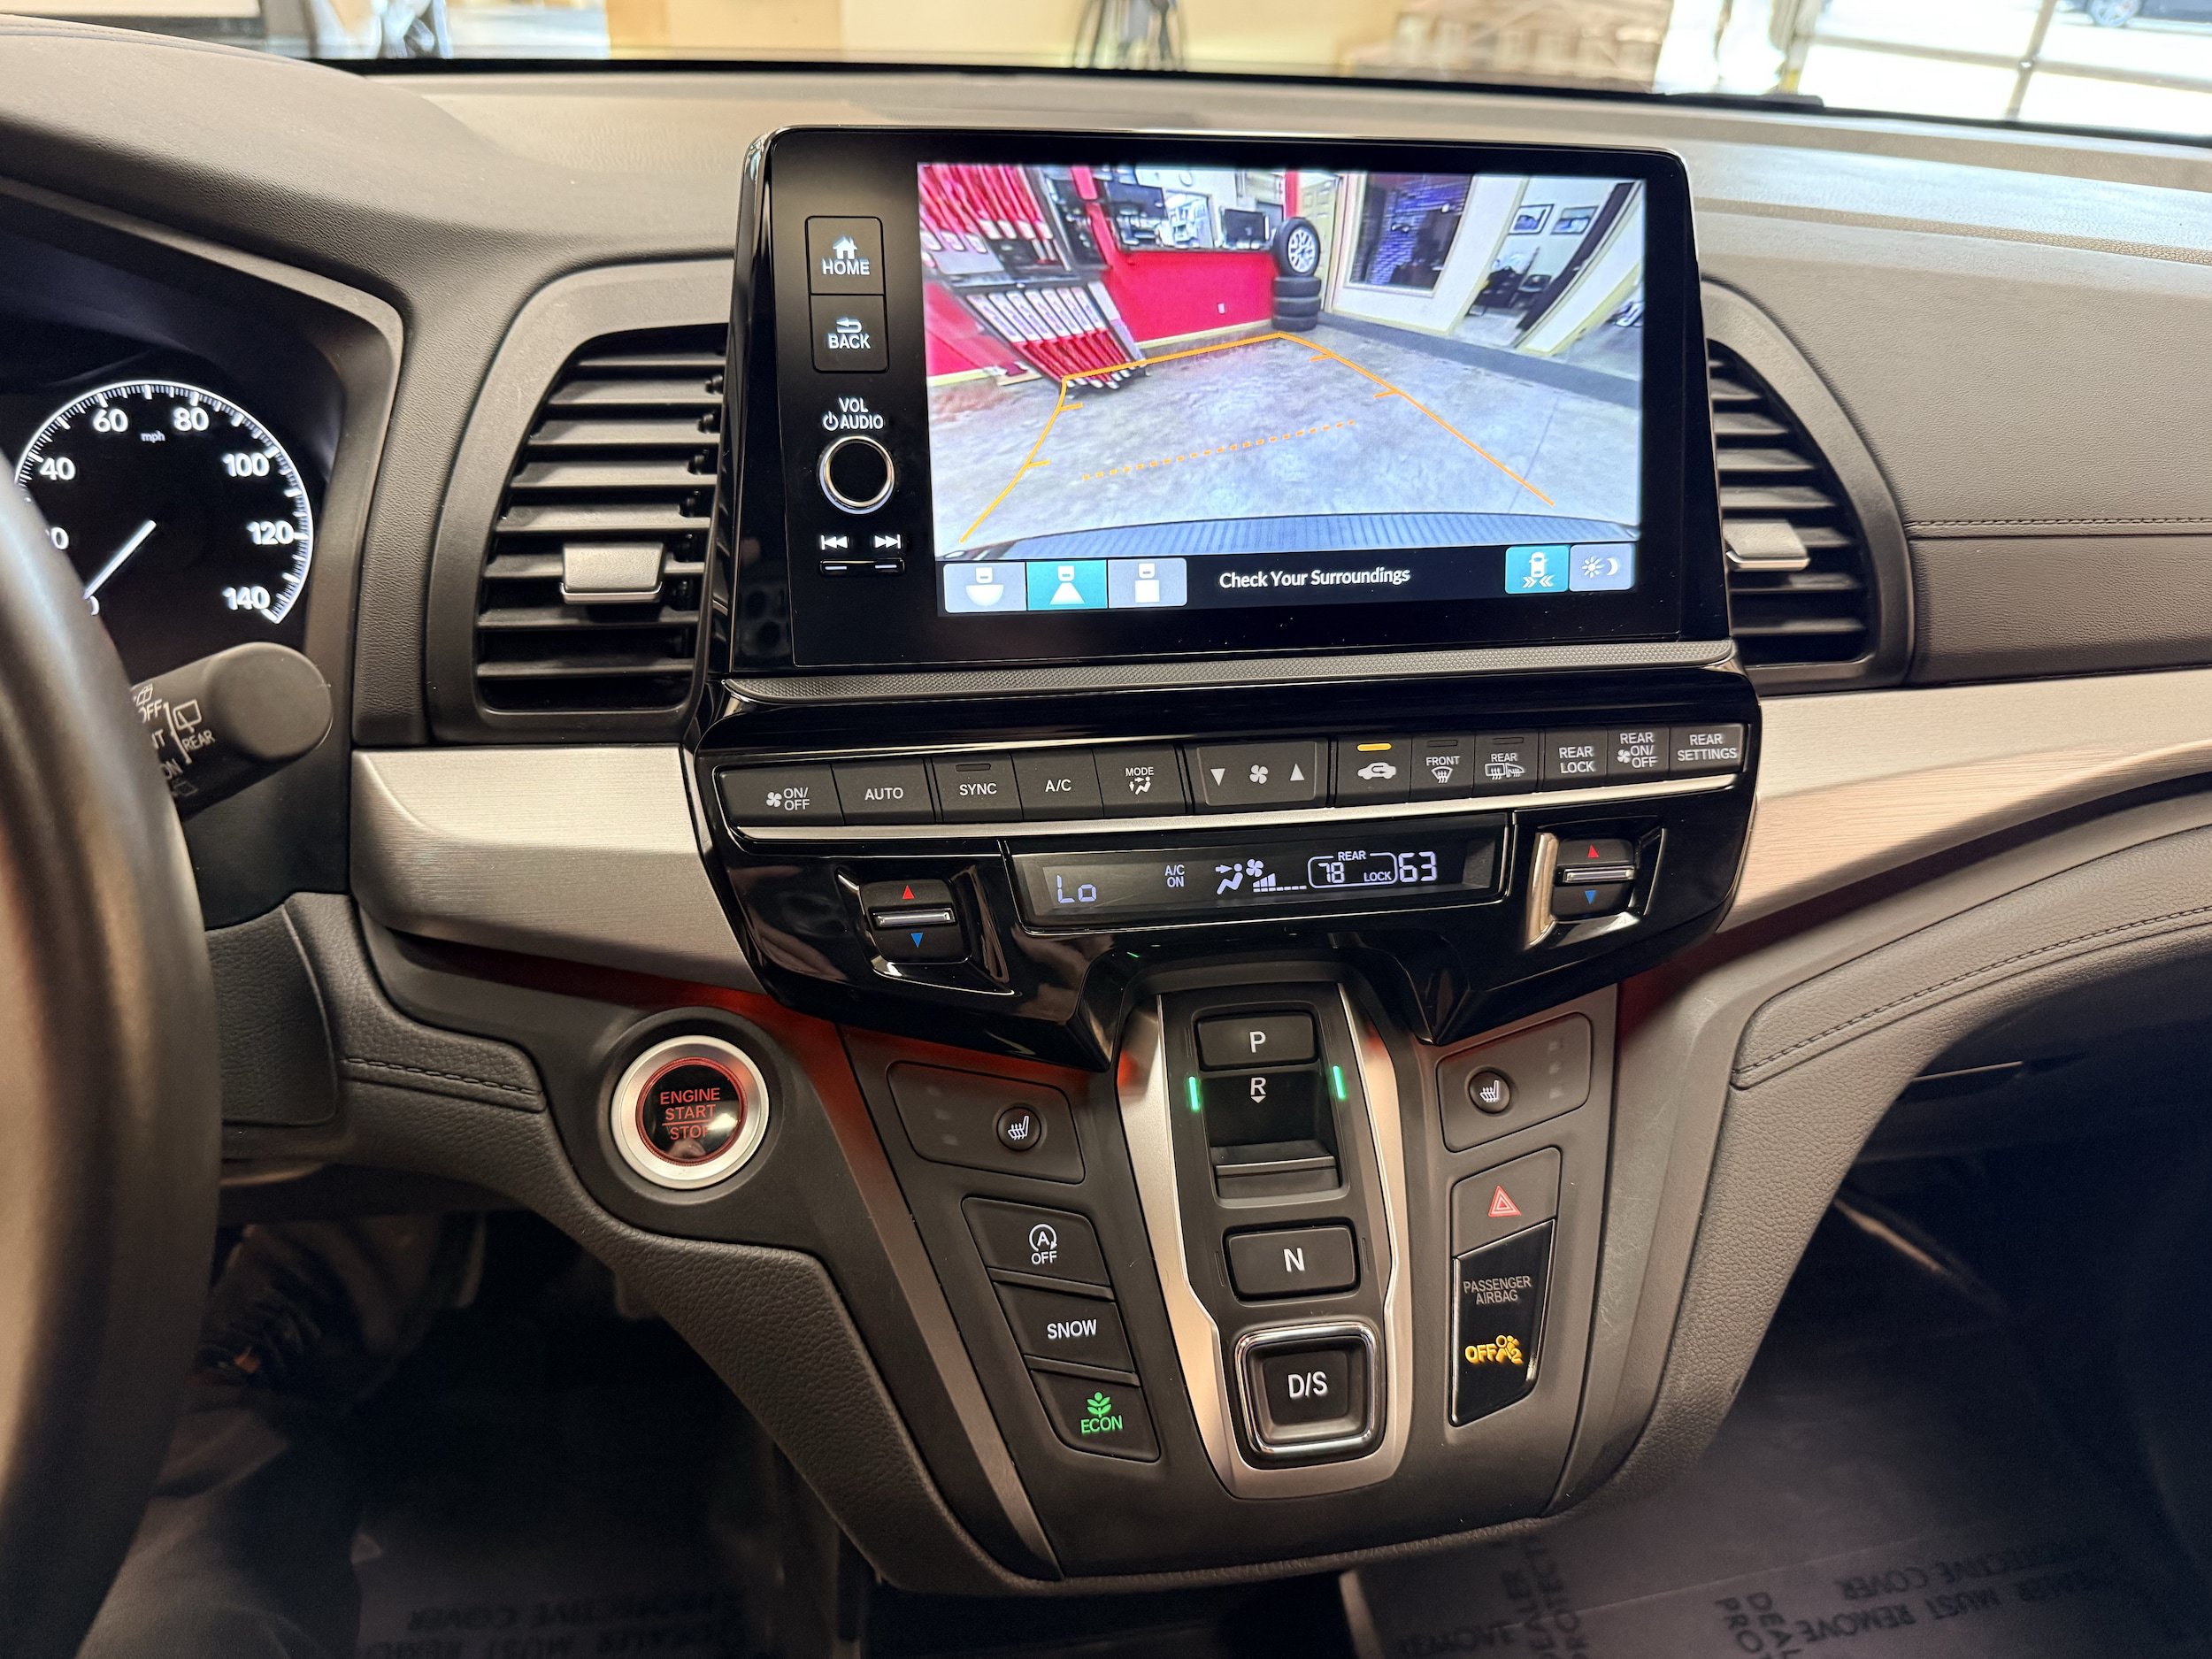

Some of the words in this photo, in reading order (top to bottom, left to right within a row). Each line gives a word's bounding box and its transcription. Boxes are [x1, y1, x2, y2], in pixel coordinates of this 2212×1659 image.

[822, 257, 870, 276] HOME
[828, 333, 871, 349] BACK
[839, 397, 868, 413] VOL
[92, 408, 129, 433] 60
[172, 407, 210, 433] 80
[840, 413, 884, 430] AUDIO
[140, 430, 166, 443] mph
[39, 457, 76, 480] 40
[221, 452, 270, 478] 100
[45, 526, 70, 549] 0
[246, 520, 296, 546] 120
[1219, 570, 1269, 589] Check
[1269, 569, 1309, 588] Your
[1310, 565, 1411, 586] Surroundings
[221, 586, 271, 611] 140
[181, 729, 216, 752] REAR
[1619, 732, 1655, 744] REAR
[1689, 733, 1724, 746] REAR
[1491, 753, 1518, 763] REAR
[1558, 746, 1594, 759] REAR
[1629, 744, 1655, 757] ON/
[1677, 747, 1738, 762] SETTINGS
[1425, 756, 1461, 766] FRONT
[1560, 760, 1595, 774] LOCK
[1631, 756, 1659, 769] OFF
[1125, 766, 1155, 778] MODE
[783, 787, 809, 799] ON/
[864, 787, 904, 801] AUTO
[958, 783, 997, 796] SYNC
[1045, 779, 1072, 793] A/C
[784, 798, 810, 811] OFF
[1337, 849, 1367, 862] REAR
[1164, 864, 1186, 876] A/C
[1317, 861, 1346, 884] 78
[1363, 871, 1393, 883] LOCK
[1397, 851, 1438, 883] 63
[1056, 874, 1097, 904] Lo
[1166, 876, 1186, 888] ON
[1248, 1030, 1267, 1054] P
[1248, 1076, 1268, 1096] R
[659, 1087, 721, 1105] ENGINE
[664, 1103, 717, 1121] START
[1031, 1249, 1058, 1265] OFF
[1282, 1247, 1306, 1272] N
[1463, 1274, 1532, 1294] PASSENGER
[1475, 1288, 1519, 1305] AIRBAG
[1047, 1318, 1098, 1340] SNOW
[1465, 1343, 1497, 1364] OFF
[1287, 1371, 1328, 1400] D/S
[1080, 1415, 1124, 1434] ECON
[1714, 1596, 1773, 1659] PRO
